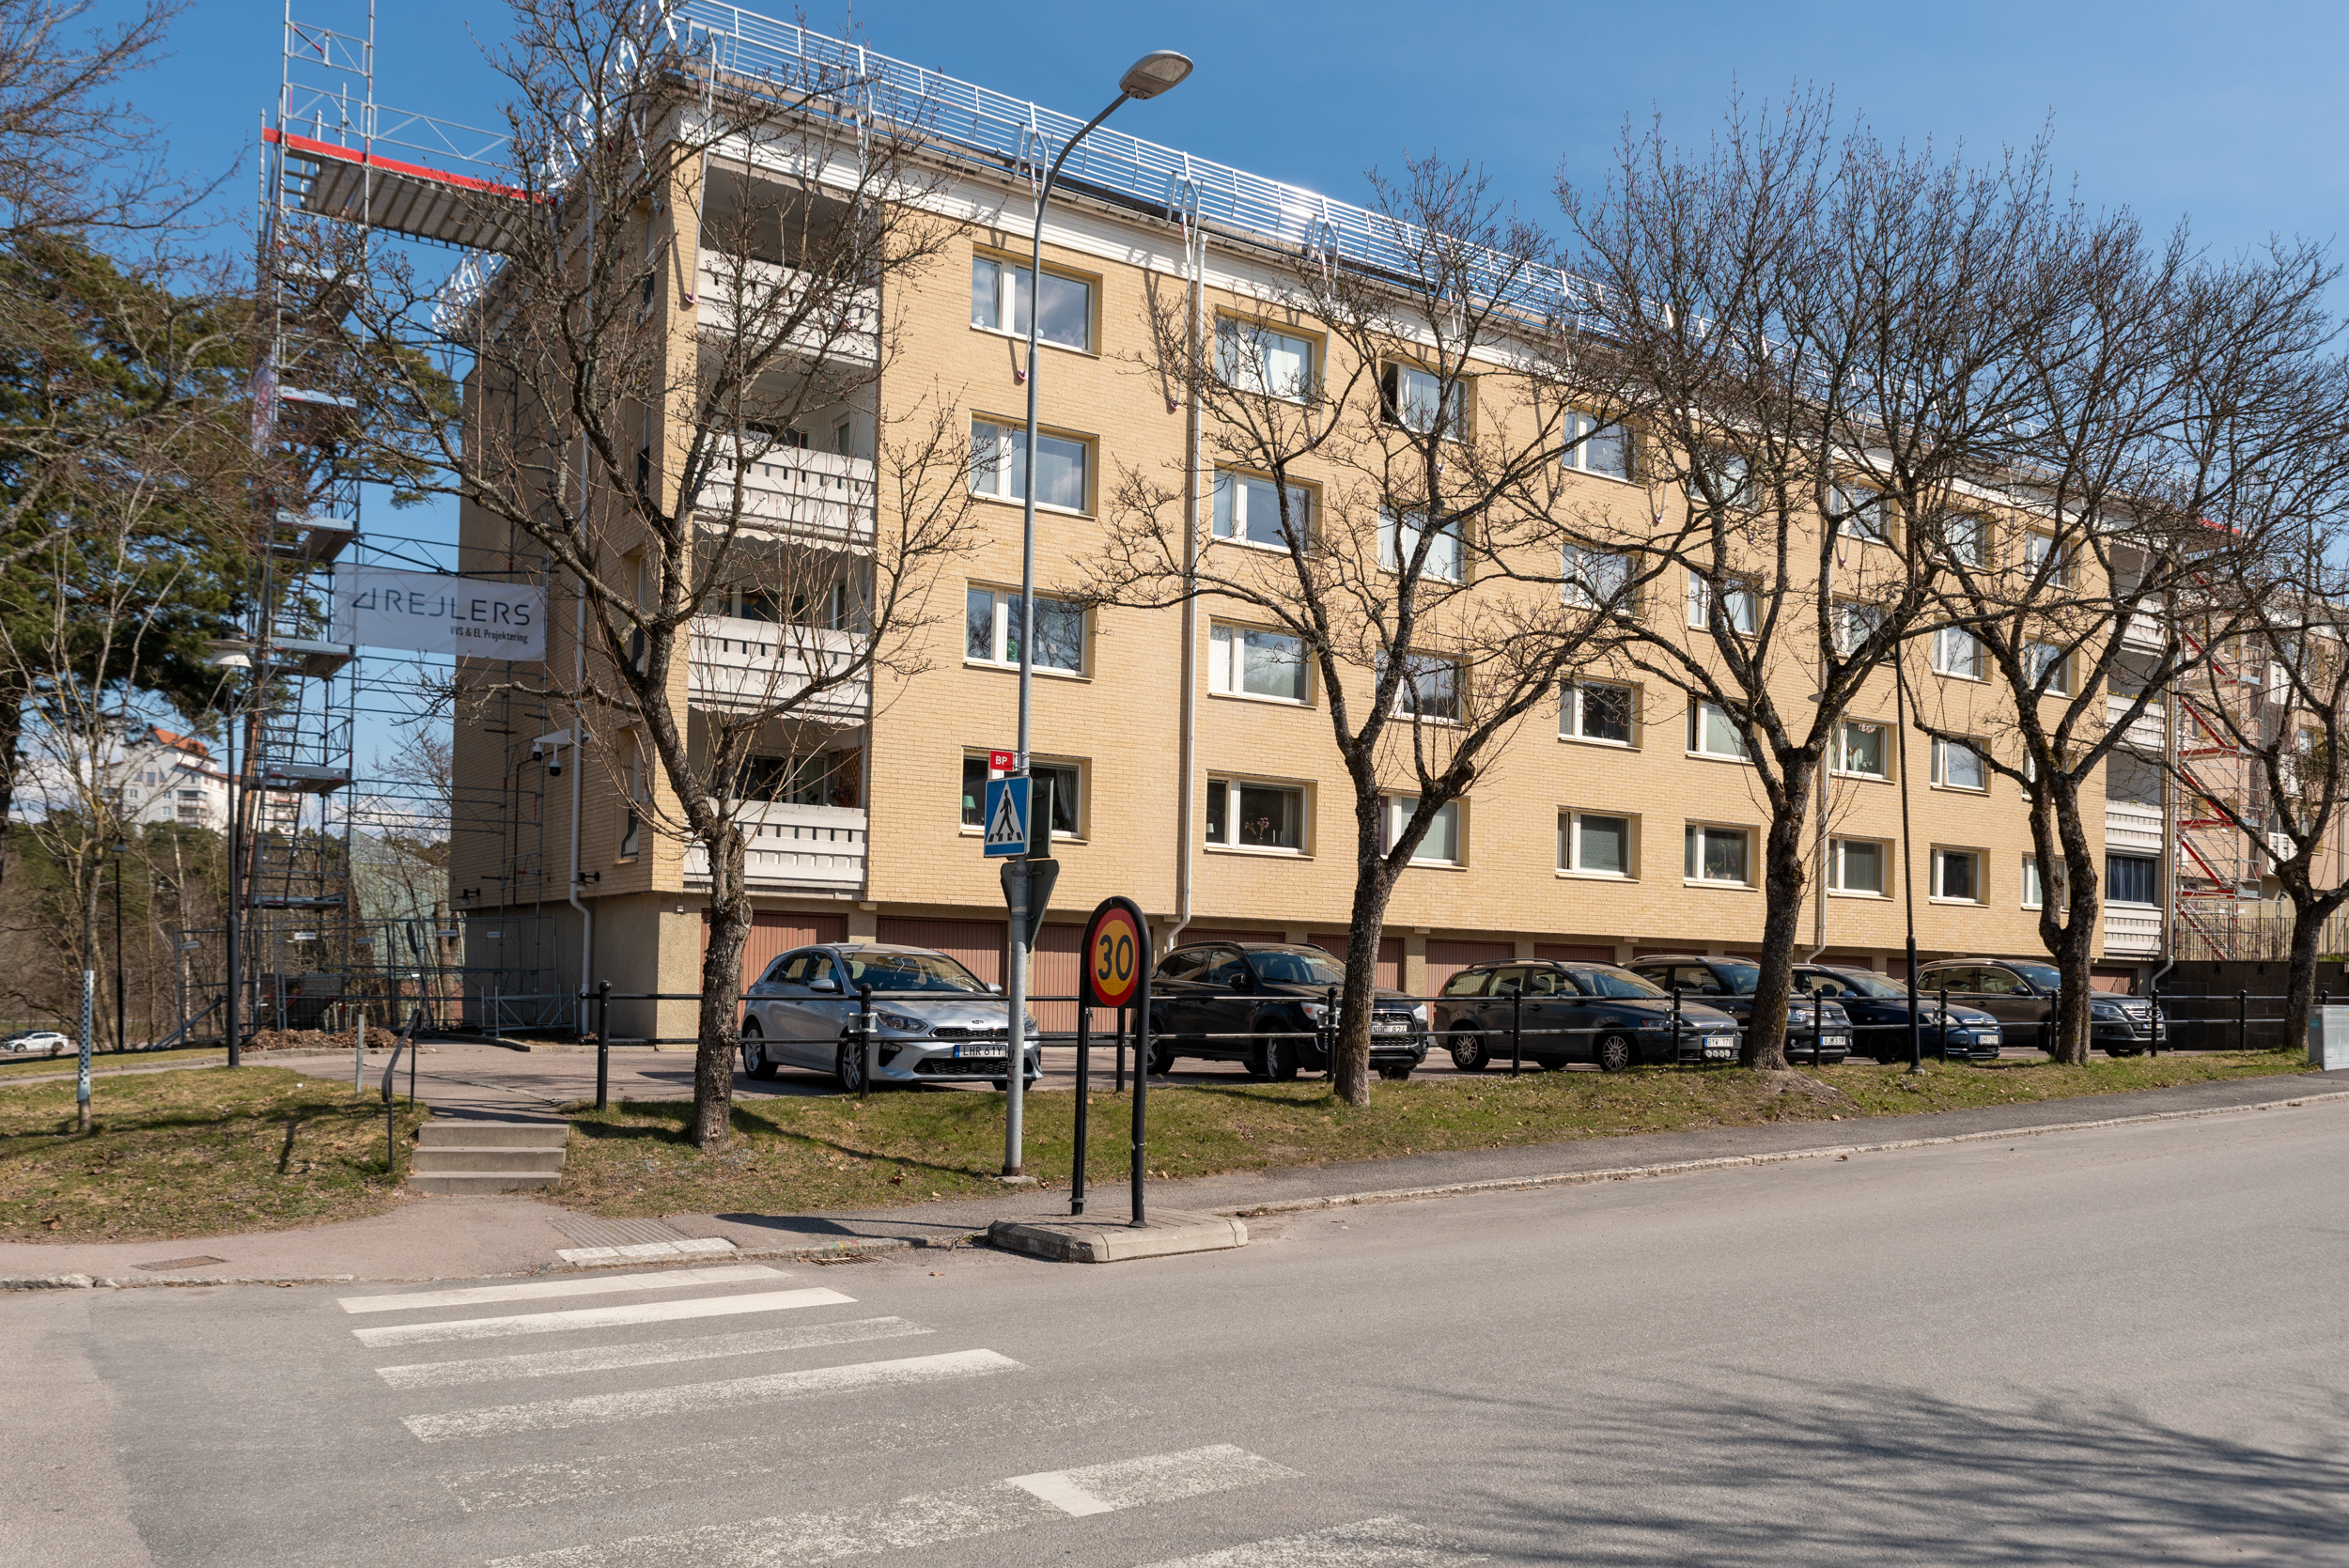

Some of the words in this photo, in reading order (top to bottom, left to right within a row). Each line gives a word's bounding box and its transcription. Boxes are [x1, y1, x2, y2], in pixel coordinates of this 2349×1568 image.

[385, 589, 530, 626] REJLERS
[450, 626, 464, 636] VVS
[465, 627, 472, 637] &
[474, 628, 482, 638] EL
[484, 629, 528, 645] Projektering
[995, 755, 1008, 766] BP
[1097, 934, 1134, 982] 30
[963, 1046, 981, 1056] LHR
[984, 1046, 1003, 1056] 61Y
